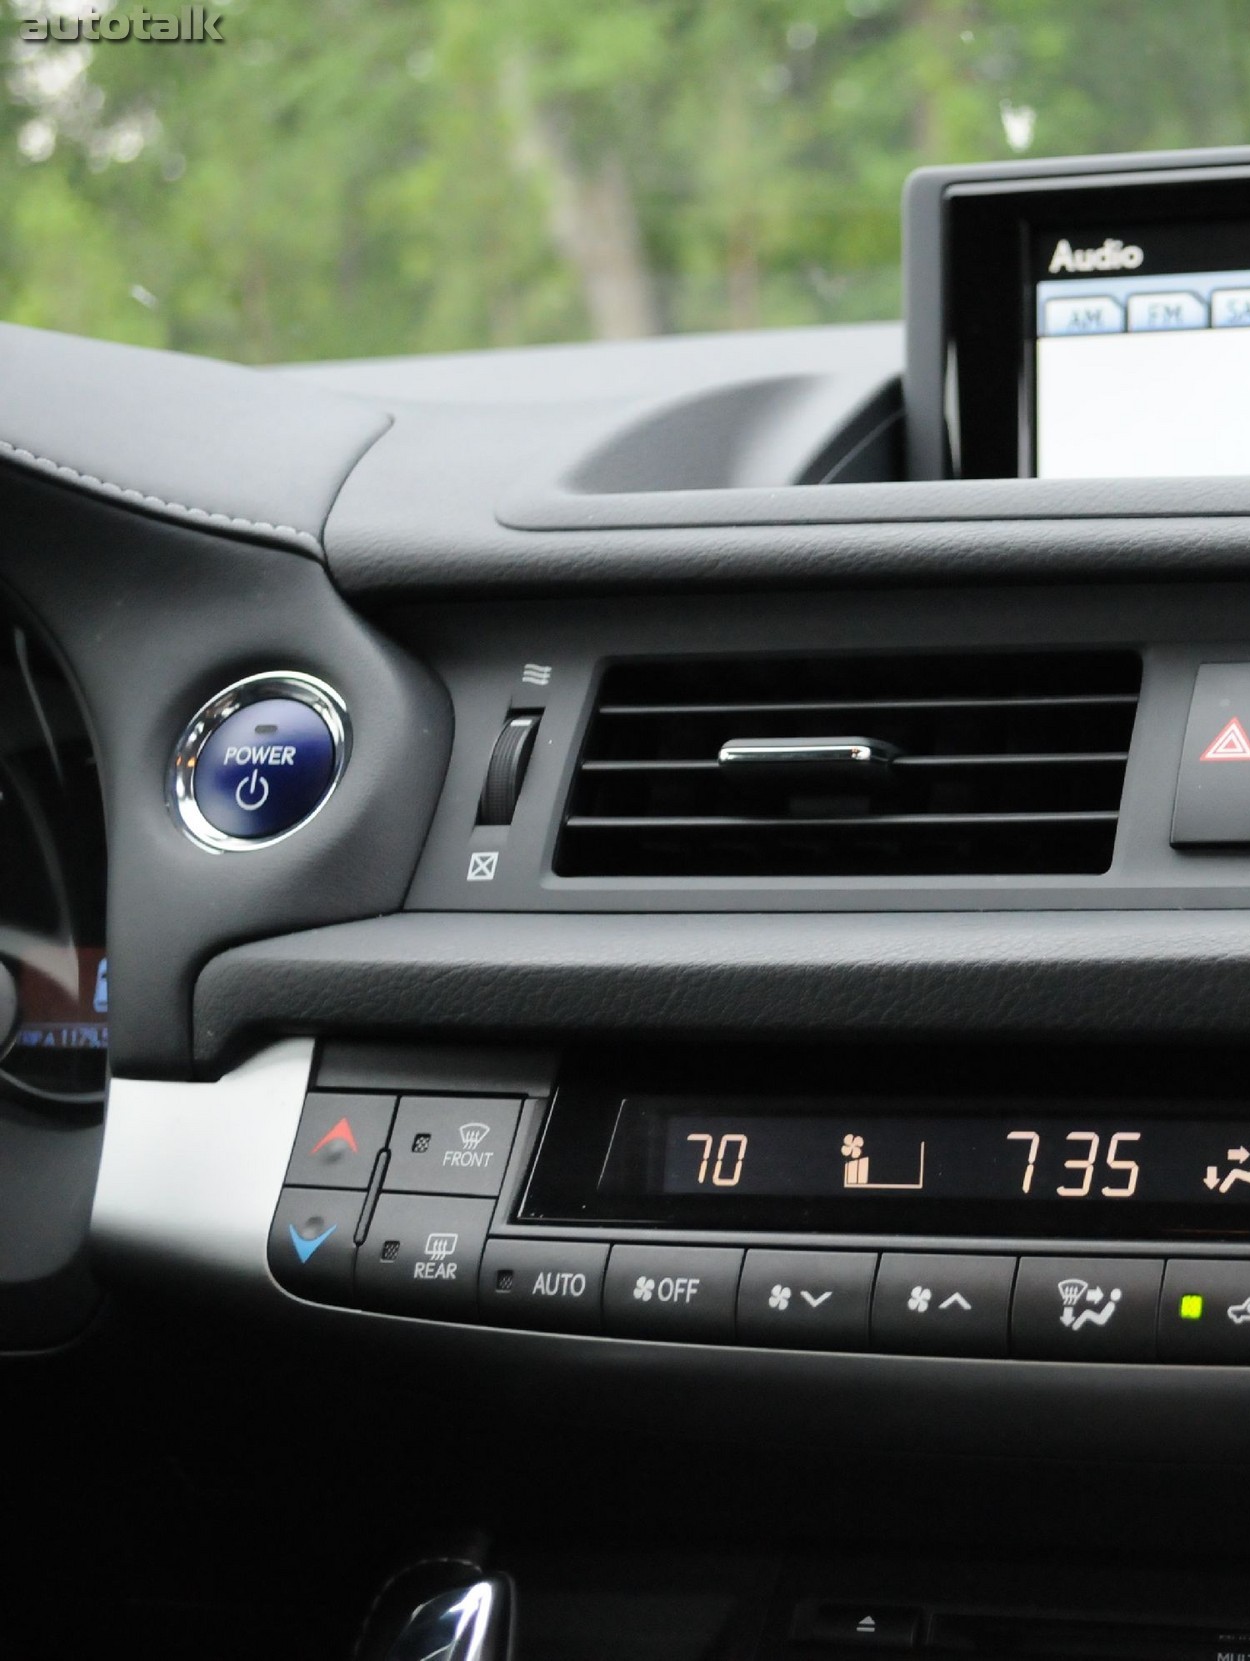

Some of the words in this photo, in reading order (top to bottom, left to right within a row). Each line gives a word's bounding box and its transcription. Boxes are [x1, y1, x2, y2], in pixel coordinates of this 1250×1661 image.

[1049, 239, 1144, 273] Audio
[1069, 307, 1103, 329] AM
[1148, 302, 1183, 325] FM
[224, 745, 296, 766] POWER
[442, 1150, 494, 1168] FRONT
[686, 1133, 748, 1188] 70
[413, 1261, 458, 1280] REAR
[532, 1273, 587, 1297] AUTO
[657, 1277, 700, 1303] OFF
